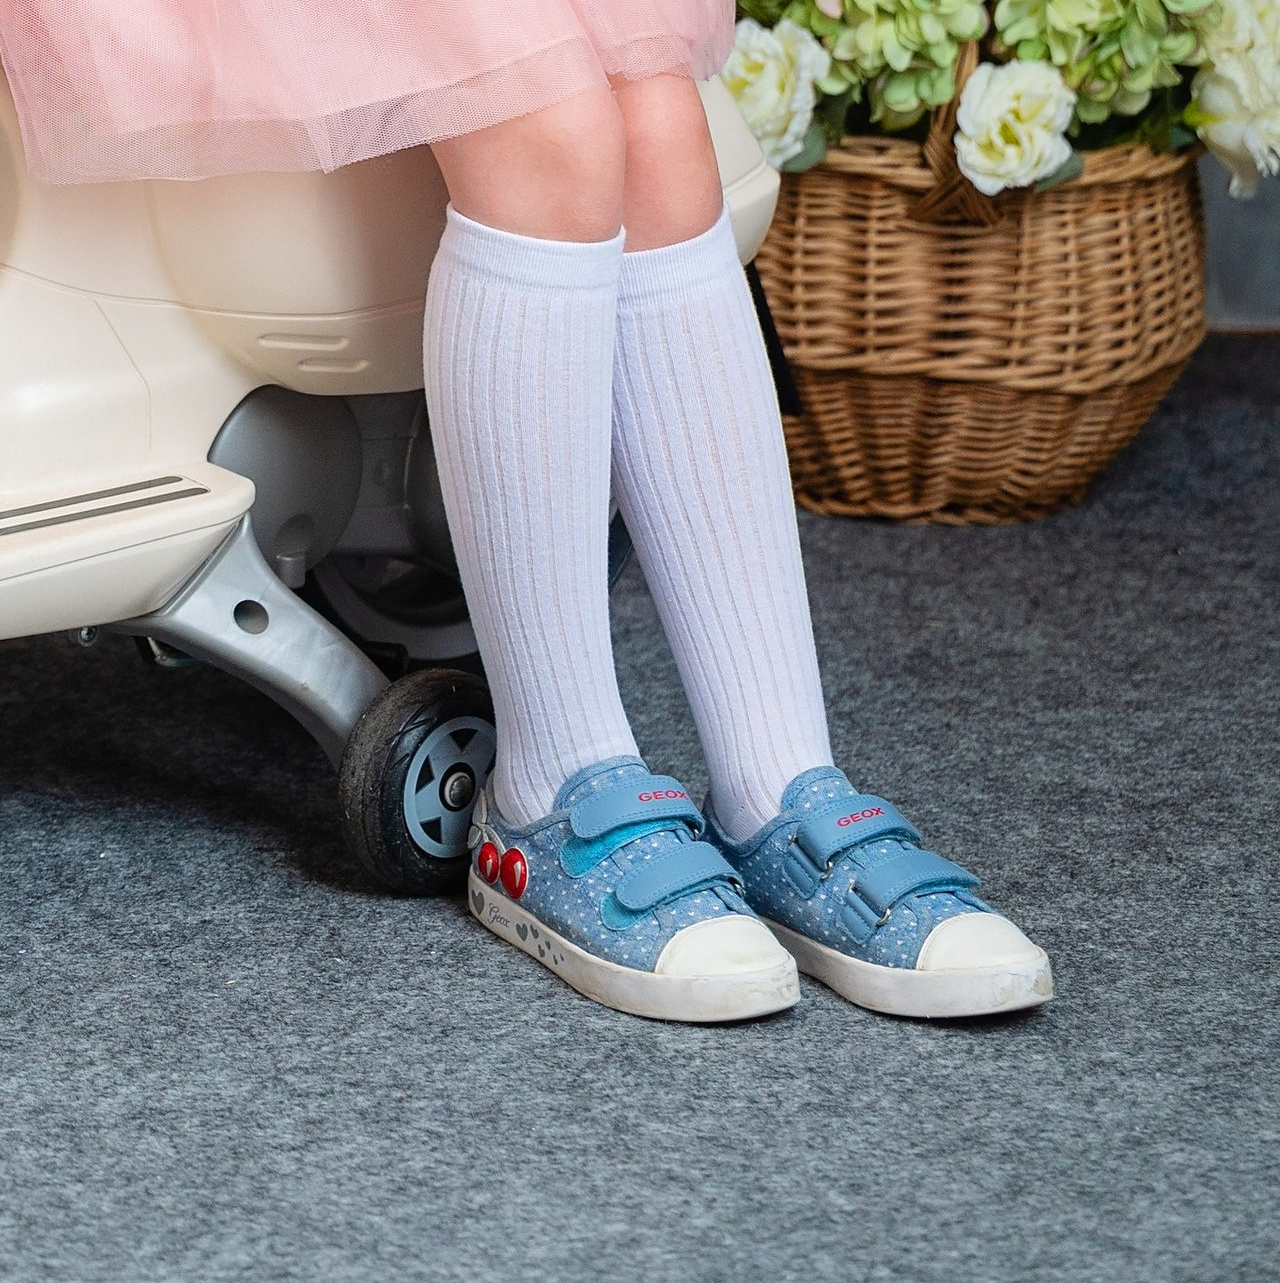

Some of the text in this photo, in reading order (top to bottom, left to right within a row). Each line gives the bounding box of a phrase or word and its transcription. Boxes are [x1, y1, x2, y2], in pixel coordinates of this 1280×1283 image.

[637, 789, 689, 803] GEOX
[836, 807, 886, 827] GEOX
[487, 902, 511, 928] Geox
